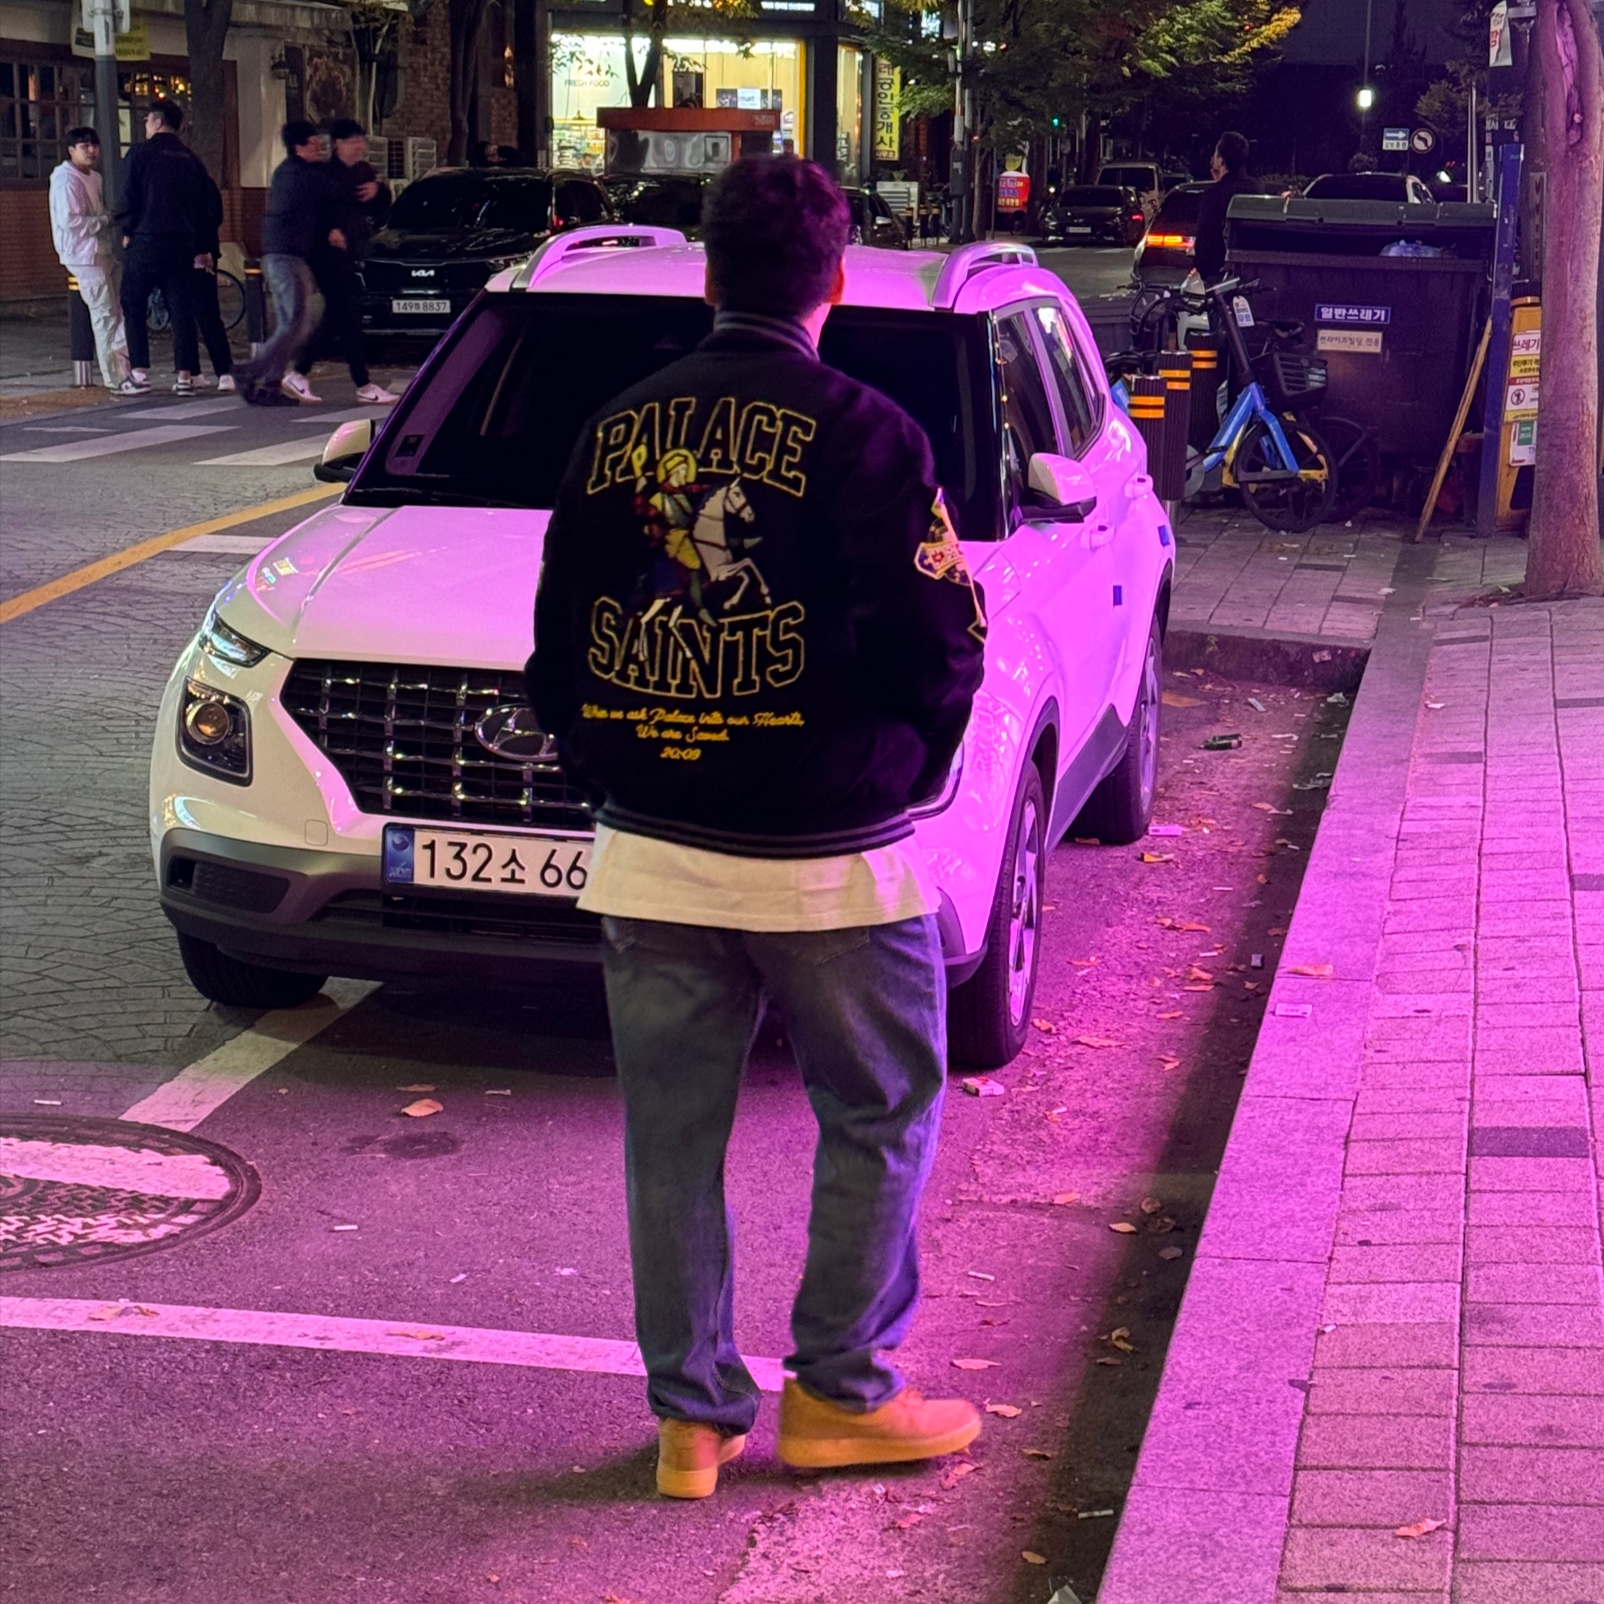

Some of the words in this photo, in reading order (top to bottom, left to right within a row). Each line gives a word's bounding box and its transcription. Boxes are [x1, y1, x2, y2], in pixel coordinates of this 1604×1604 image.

[876, 78, 896, 148] 공인중개사
[422, 301, 447, 312] 8837
[1320, 307, 1386, 322] 일반쓰레기
[586, 397, 817, 498] PALACE
[587, 595, 805, 699] SAINTS
[626, 708, 648, 720] ask
[648, 708, 695, 724] Palace
[698, 710, 724, 724] into
[727, 715, 750, 725] our
[636, 724, 659, 739] We
[661, 729, 682, 740] are
[422, 838, 526, 885] 132소
